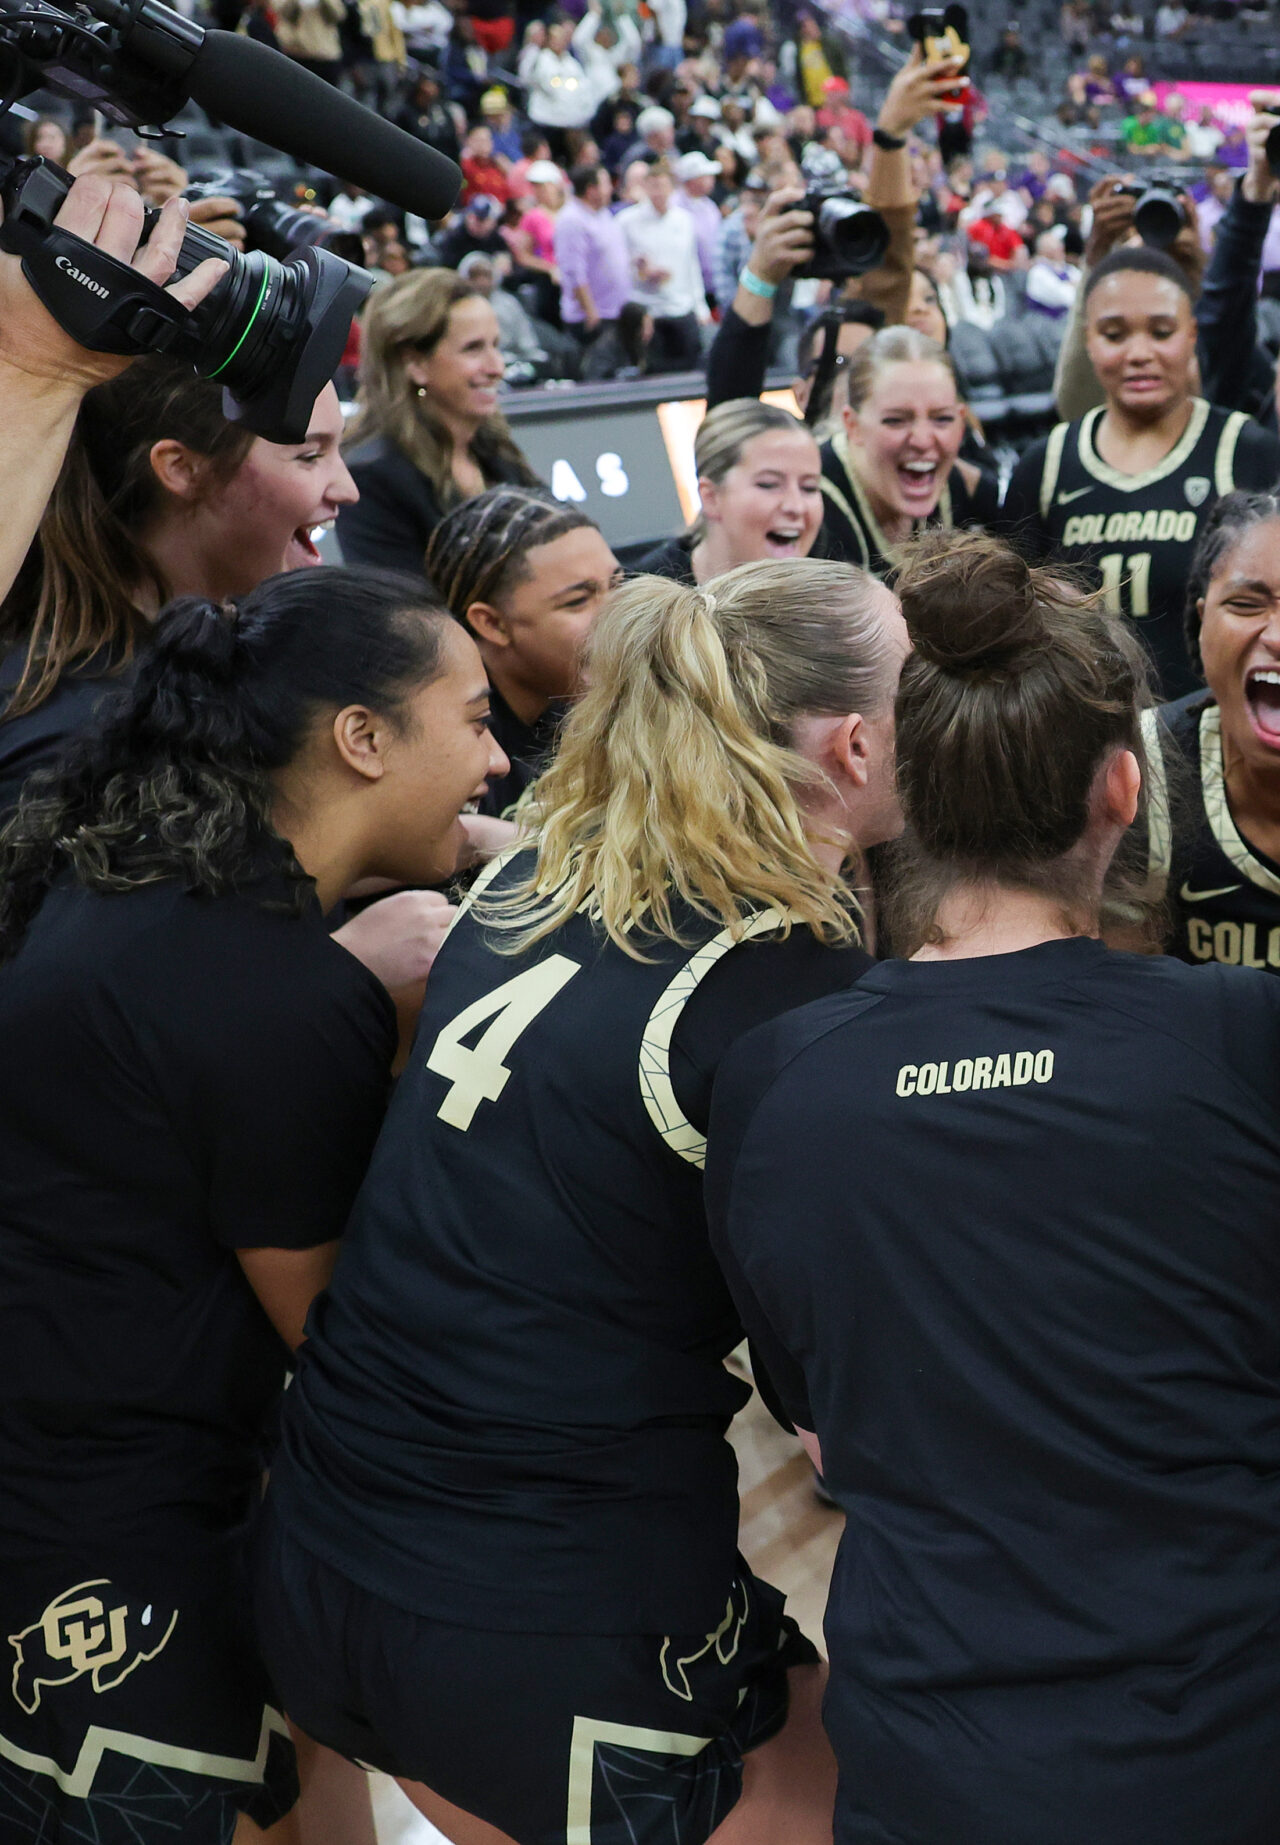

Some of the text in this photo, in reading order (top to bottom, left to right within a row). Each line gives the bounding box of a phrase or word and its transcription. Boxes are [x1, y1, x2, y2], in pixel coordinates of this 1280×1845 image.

[55, 256, 111, 300] Canon
[1063, 510, 1197, 546] COLORADO
[1100, 552, 1152, 618] 11
[425, 953, 582, 1132] 4
[895, 1049, 1055, 1098] COLORADO
